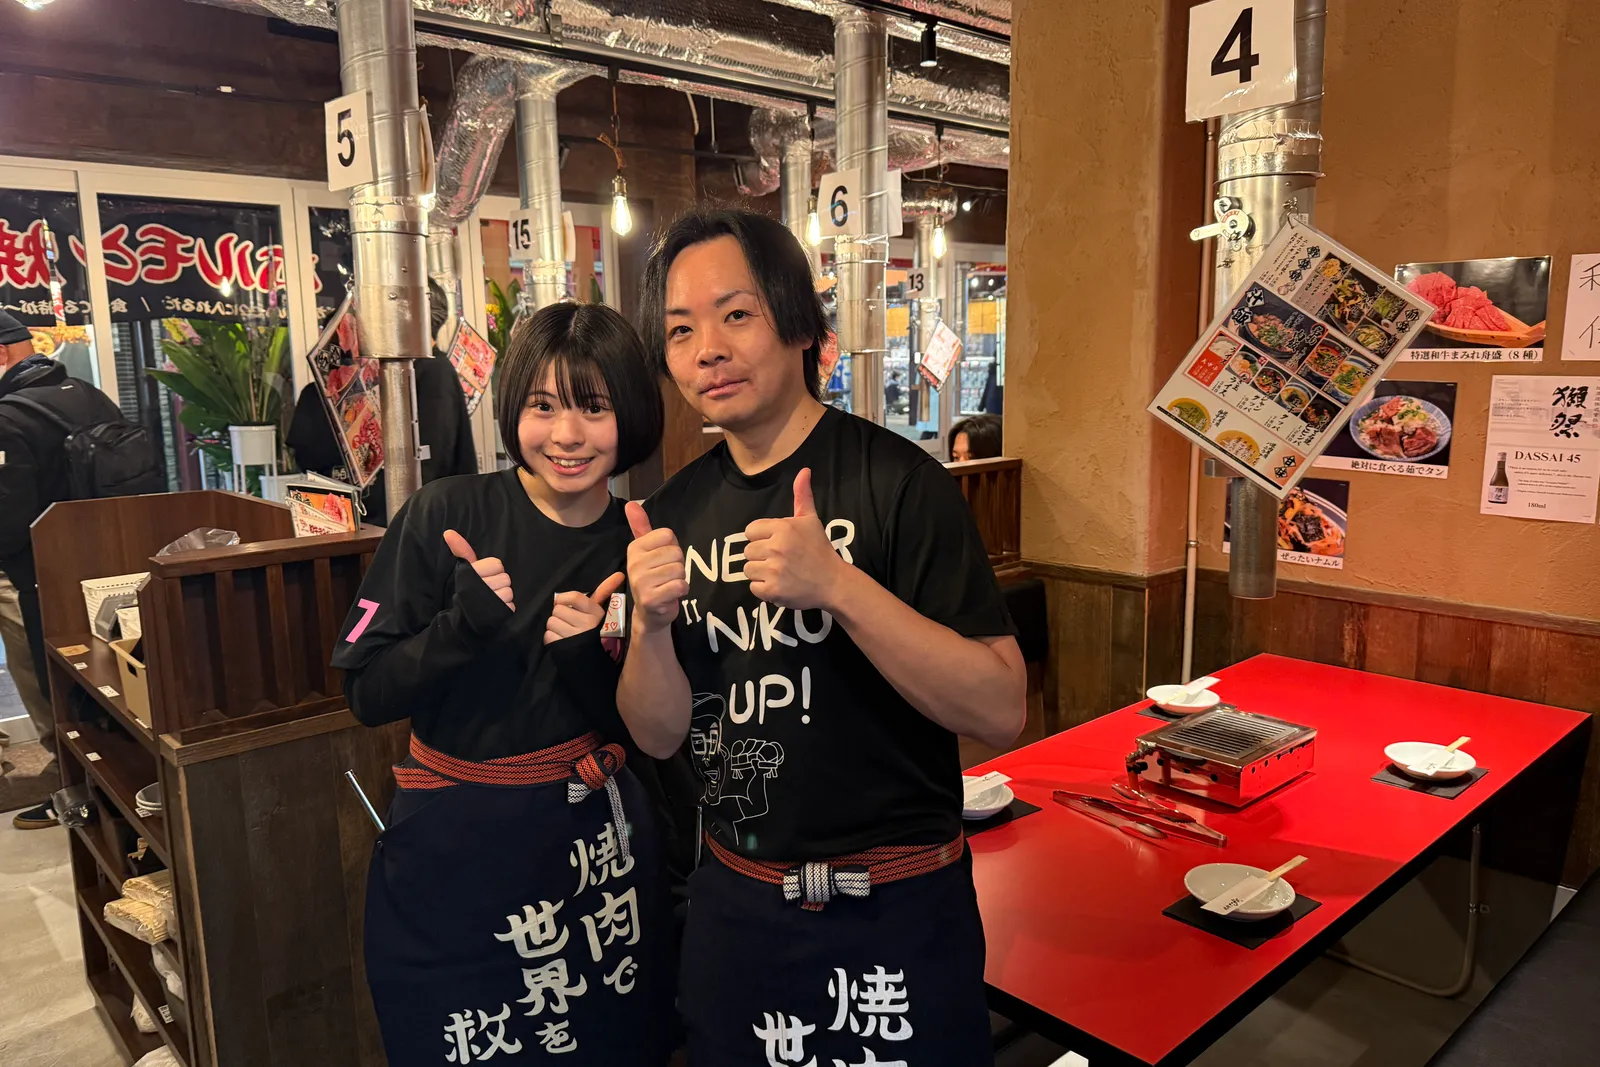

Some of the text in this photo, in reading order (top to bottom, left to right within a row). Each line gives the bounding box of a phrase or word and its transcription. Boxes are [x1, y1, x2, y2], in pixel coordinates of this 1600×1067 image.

[1210, 6, 1260, 84] 4
[336, 107, 356, 168] 5
[830, 185, 850, 228] 6
[512, 218, 532, 250] 15
[908, 273, 925, 293] 13
[1351, 459, 1445, 477] 絶対に食べる茹でタン
[1514, 450, 1582, 464] DASSAI 45
[1527, 501, 1547, 510] 180ml
[685, 518, 855, 585] NER
[1280, 552, 1340, 567] ぜったいナムル
[344, 597, 381, 644] 7
[728, 665, 812, 726] UP!
[569, 821, 641, 995] 焼肉で
[493, 898, 588, 1055] 世界を
[443, 1002, 523, 1066] 救
